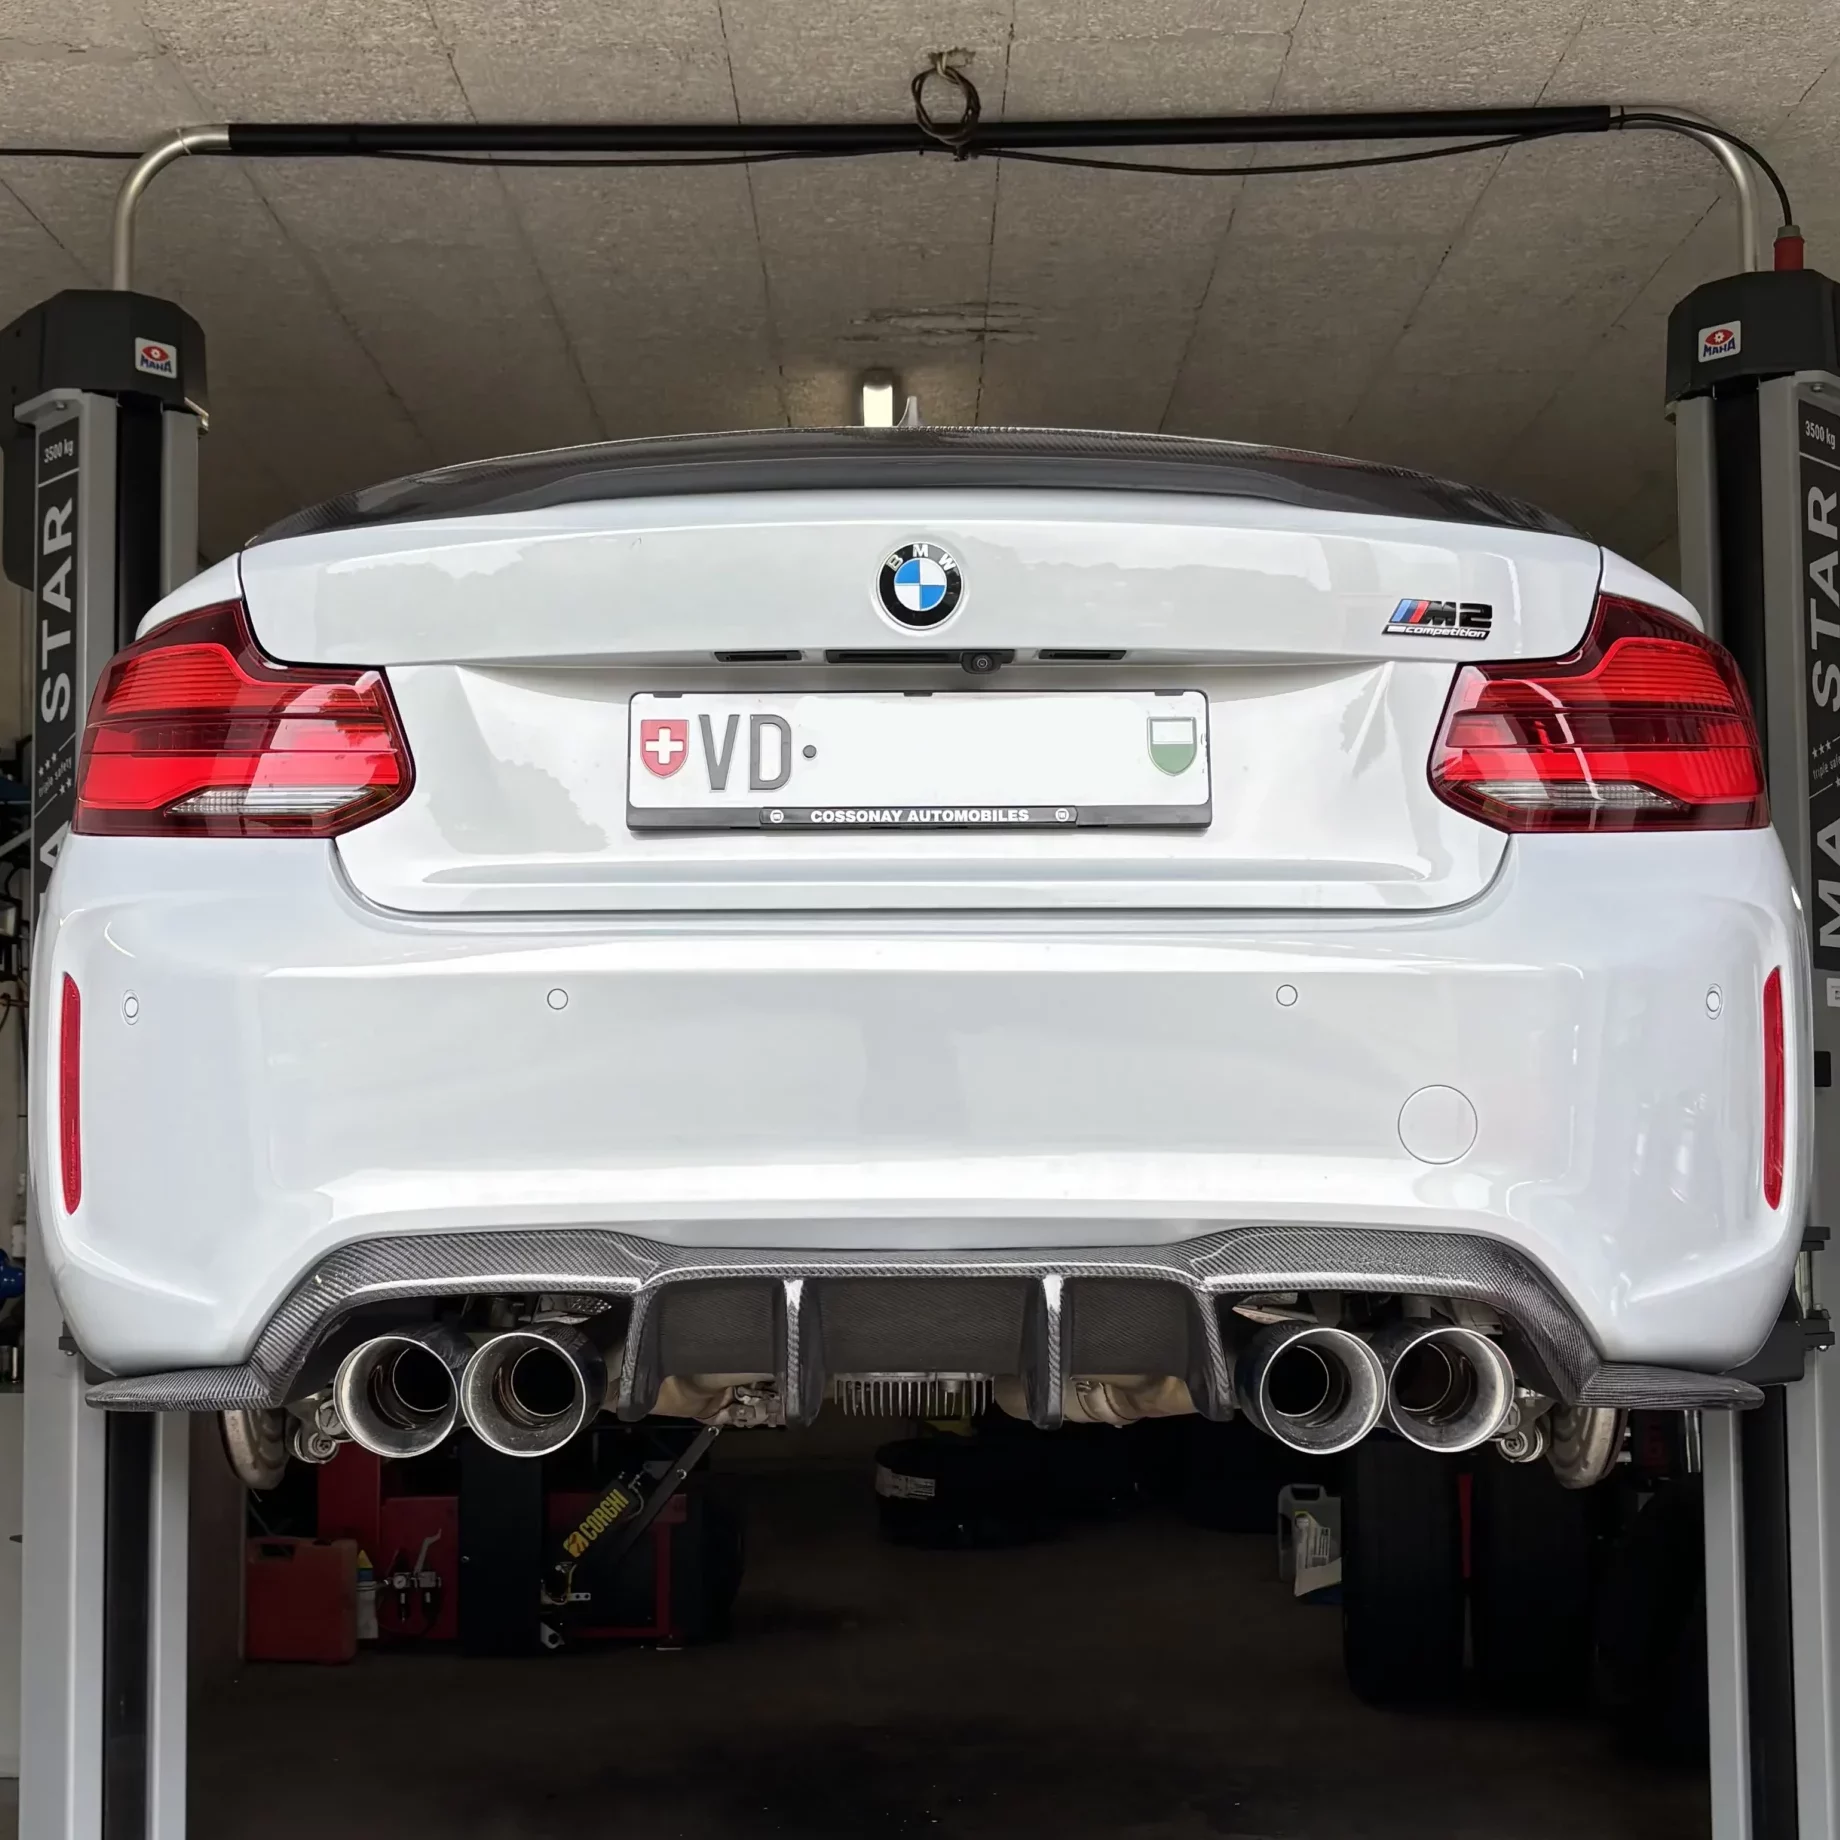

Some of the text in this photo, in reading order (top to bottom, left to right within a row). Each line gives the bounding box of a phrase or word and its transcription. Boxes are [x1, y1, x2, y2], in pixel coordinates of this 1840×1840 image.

[1703, 337, 1736, 357] MAHA
[1805, 420, 1836, 450] 3500 kg
[44, 438, 74, 463] 3500 kg
[886, 543, 957, 572] BMW
[41, 498, 73, 723] STAR
[1808, 486, 1840, 713] STAR
[1419, 600, 1493, 629] M2
[1405, 626, 1487, 638] competition
[810, 809, 1029, 823] COSSONAY AUTOMOBILES
[579, 1488, 630, 1541] CORGHI
